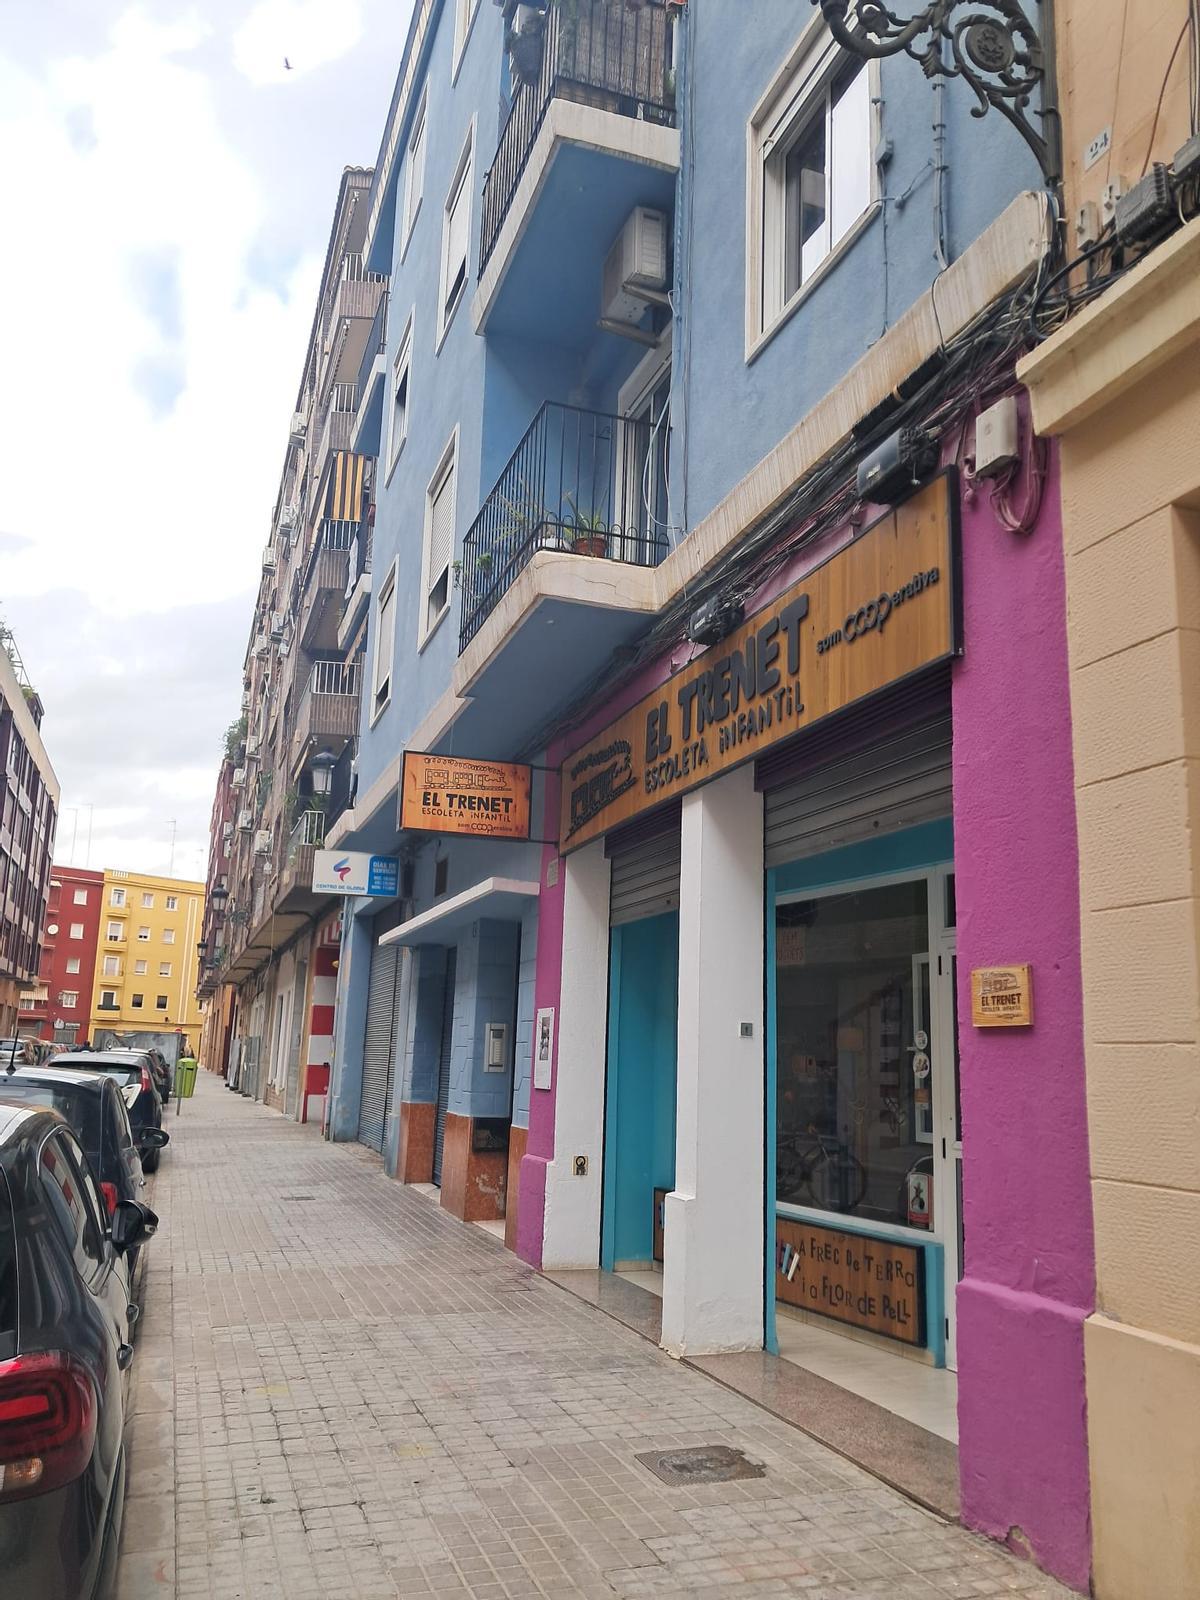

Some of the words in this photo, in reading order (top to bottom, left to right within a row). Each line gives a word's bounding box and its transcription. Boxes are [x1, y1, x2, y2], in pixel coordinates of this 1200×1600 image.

[1090, 132, 1109, 160] 24
[645, 699, 673, 763] EL
[678, 594, 809, 741] TRENET
[644, 742, 710, 794] ESCOLETA
[421, 807, 465, 818] ESCOLETA
[422, 791, 441, 807] EL
[446, 793, 513, 814] TRENET
[981, 996, 990, 1007] EL
[991, 992, 1022, 1007] TRENET
